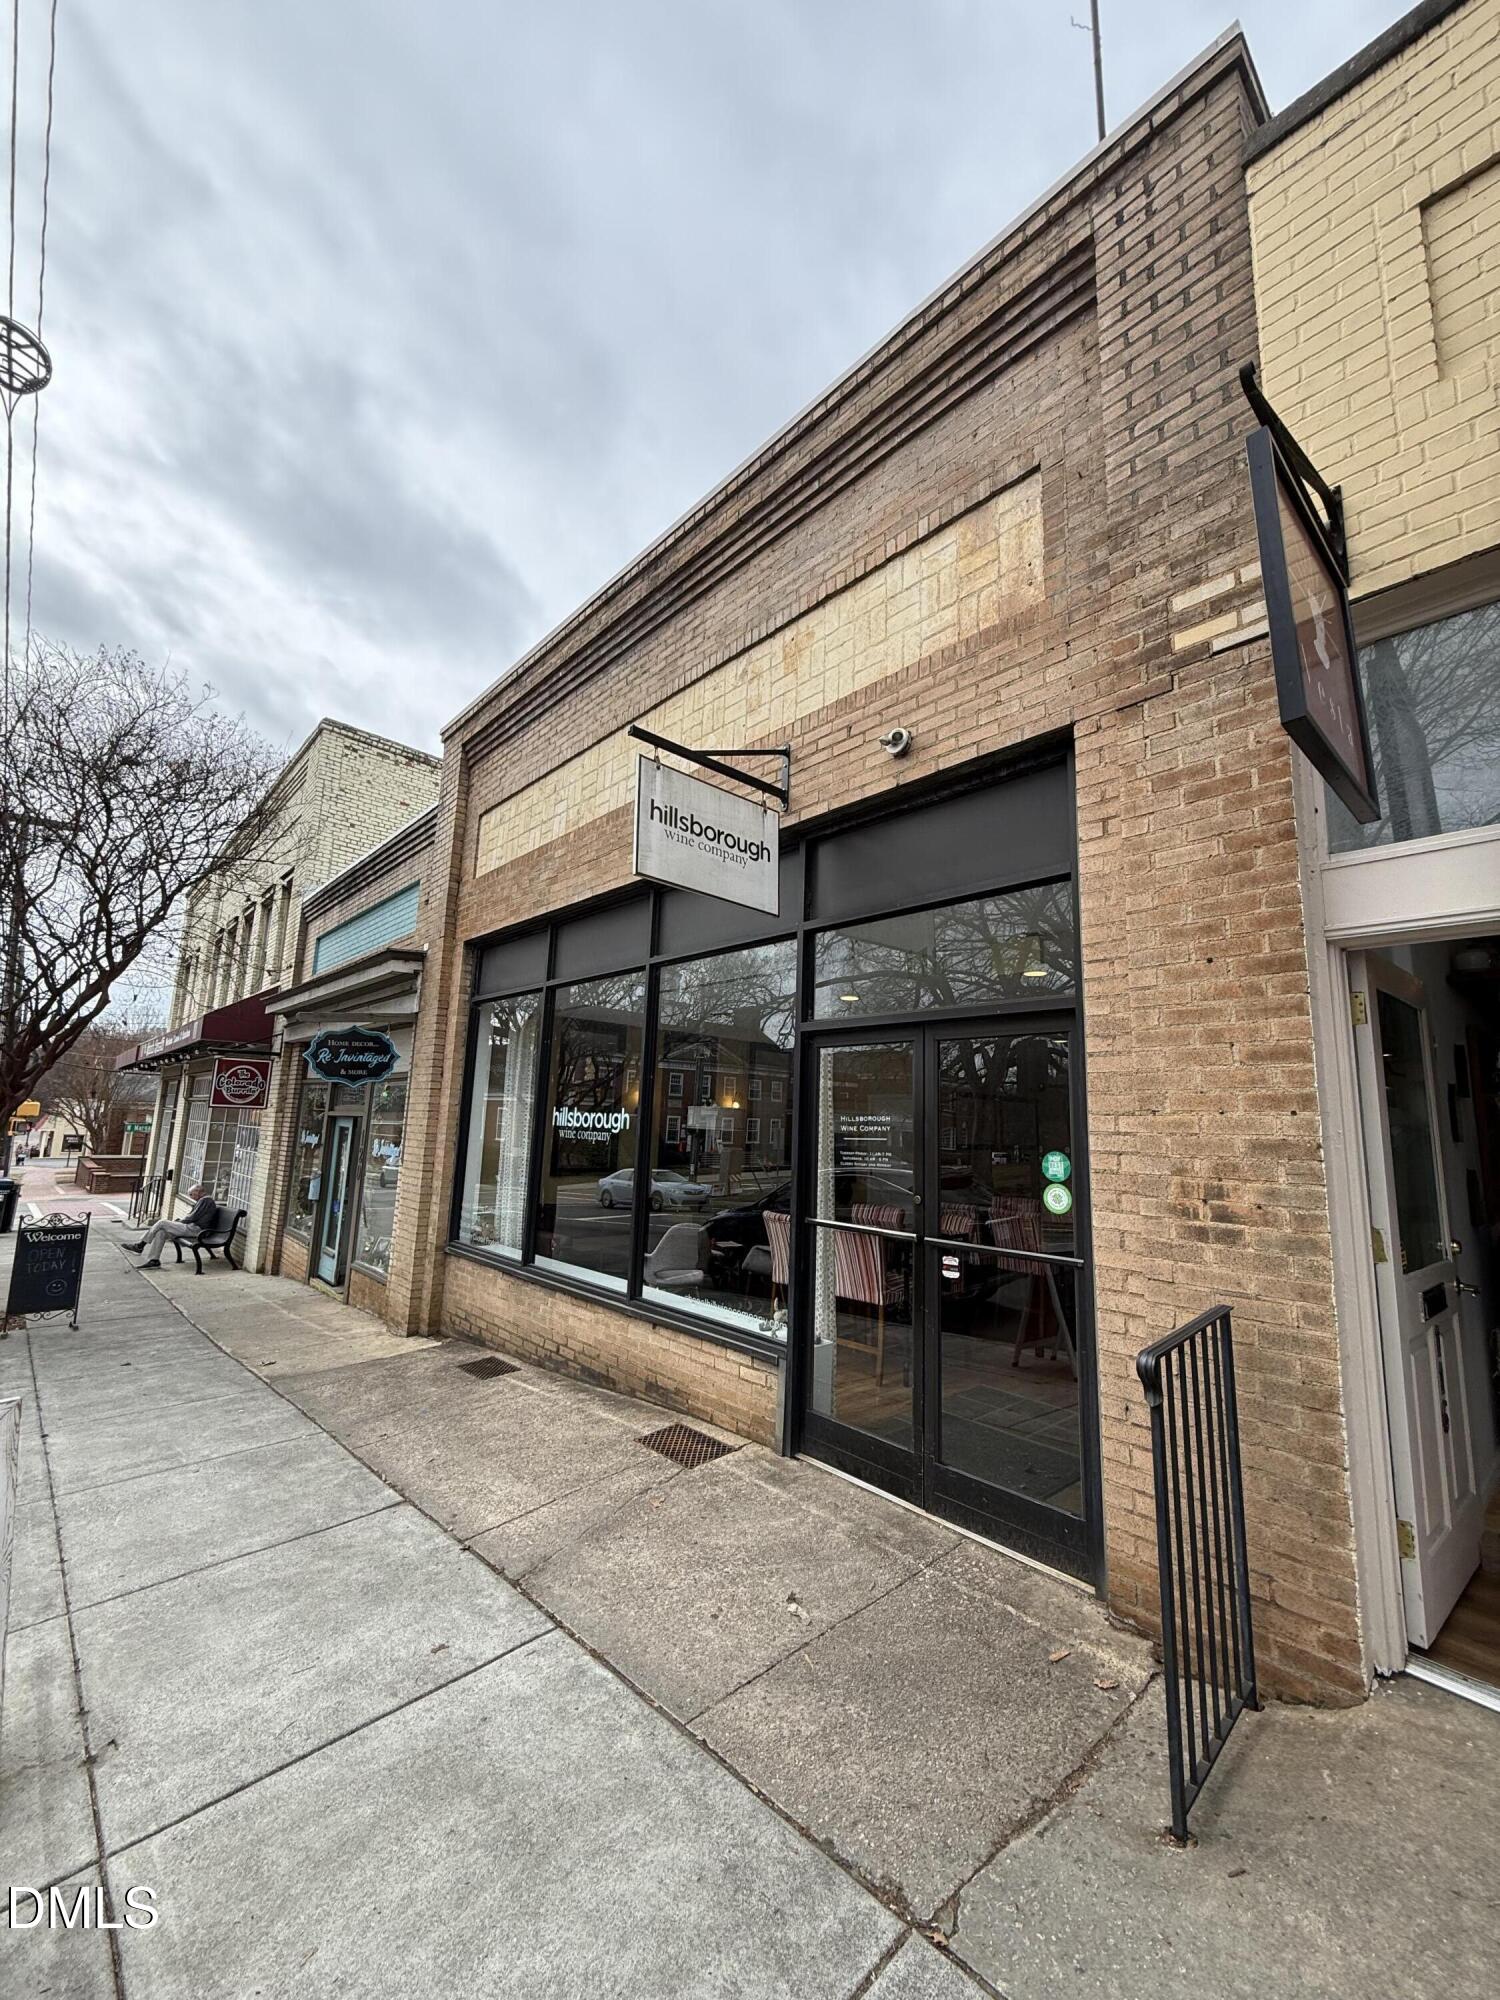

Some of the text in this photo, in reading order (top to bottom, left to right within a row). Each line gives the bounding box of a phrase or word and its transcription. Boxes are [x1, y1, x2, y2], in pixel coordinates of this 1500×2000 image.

[650, 799, 771, 863] hillsborough
[664, 829, 748, 869] wine company
[216, 1074, 266, 1090] Colorado
[552, 1106, 630, 1133] hillsborough
[559, 1129, 612, 1145] wine company
[24, 1231, 81, 1242] Welcome
[31, 1247, 65, 1261] OPEN
